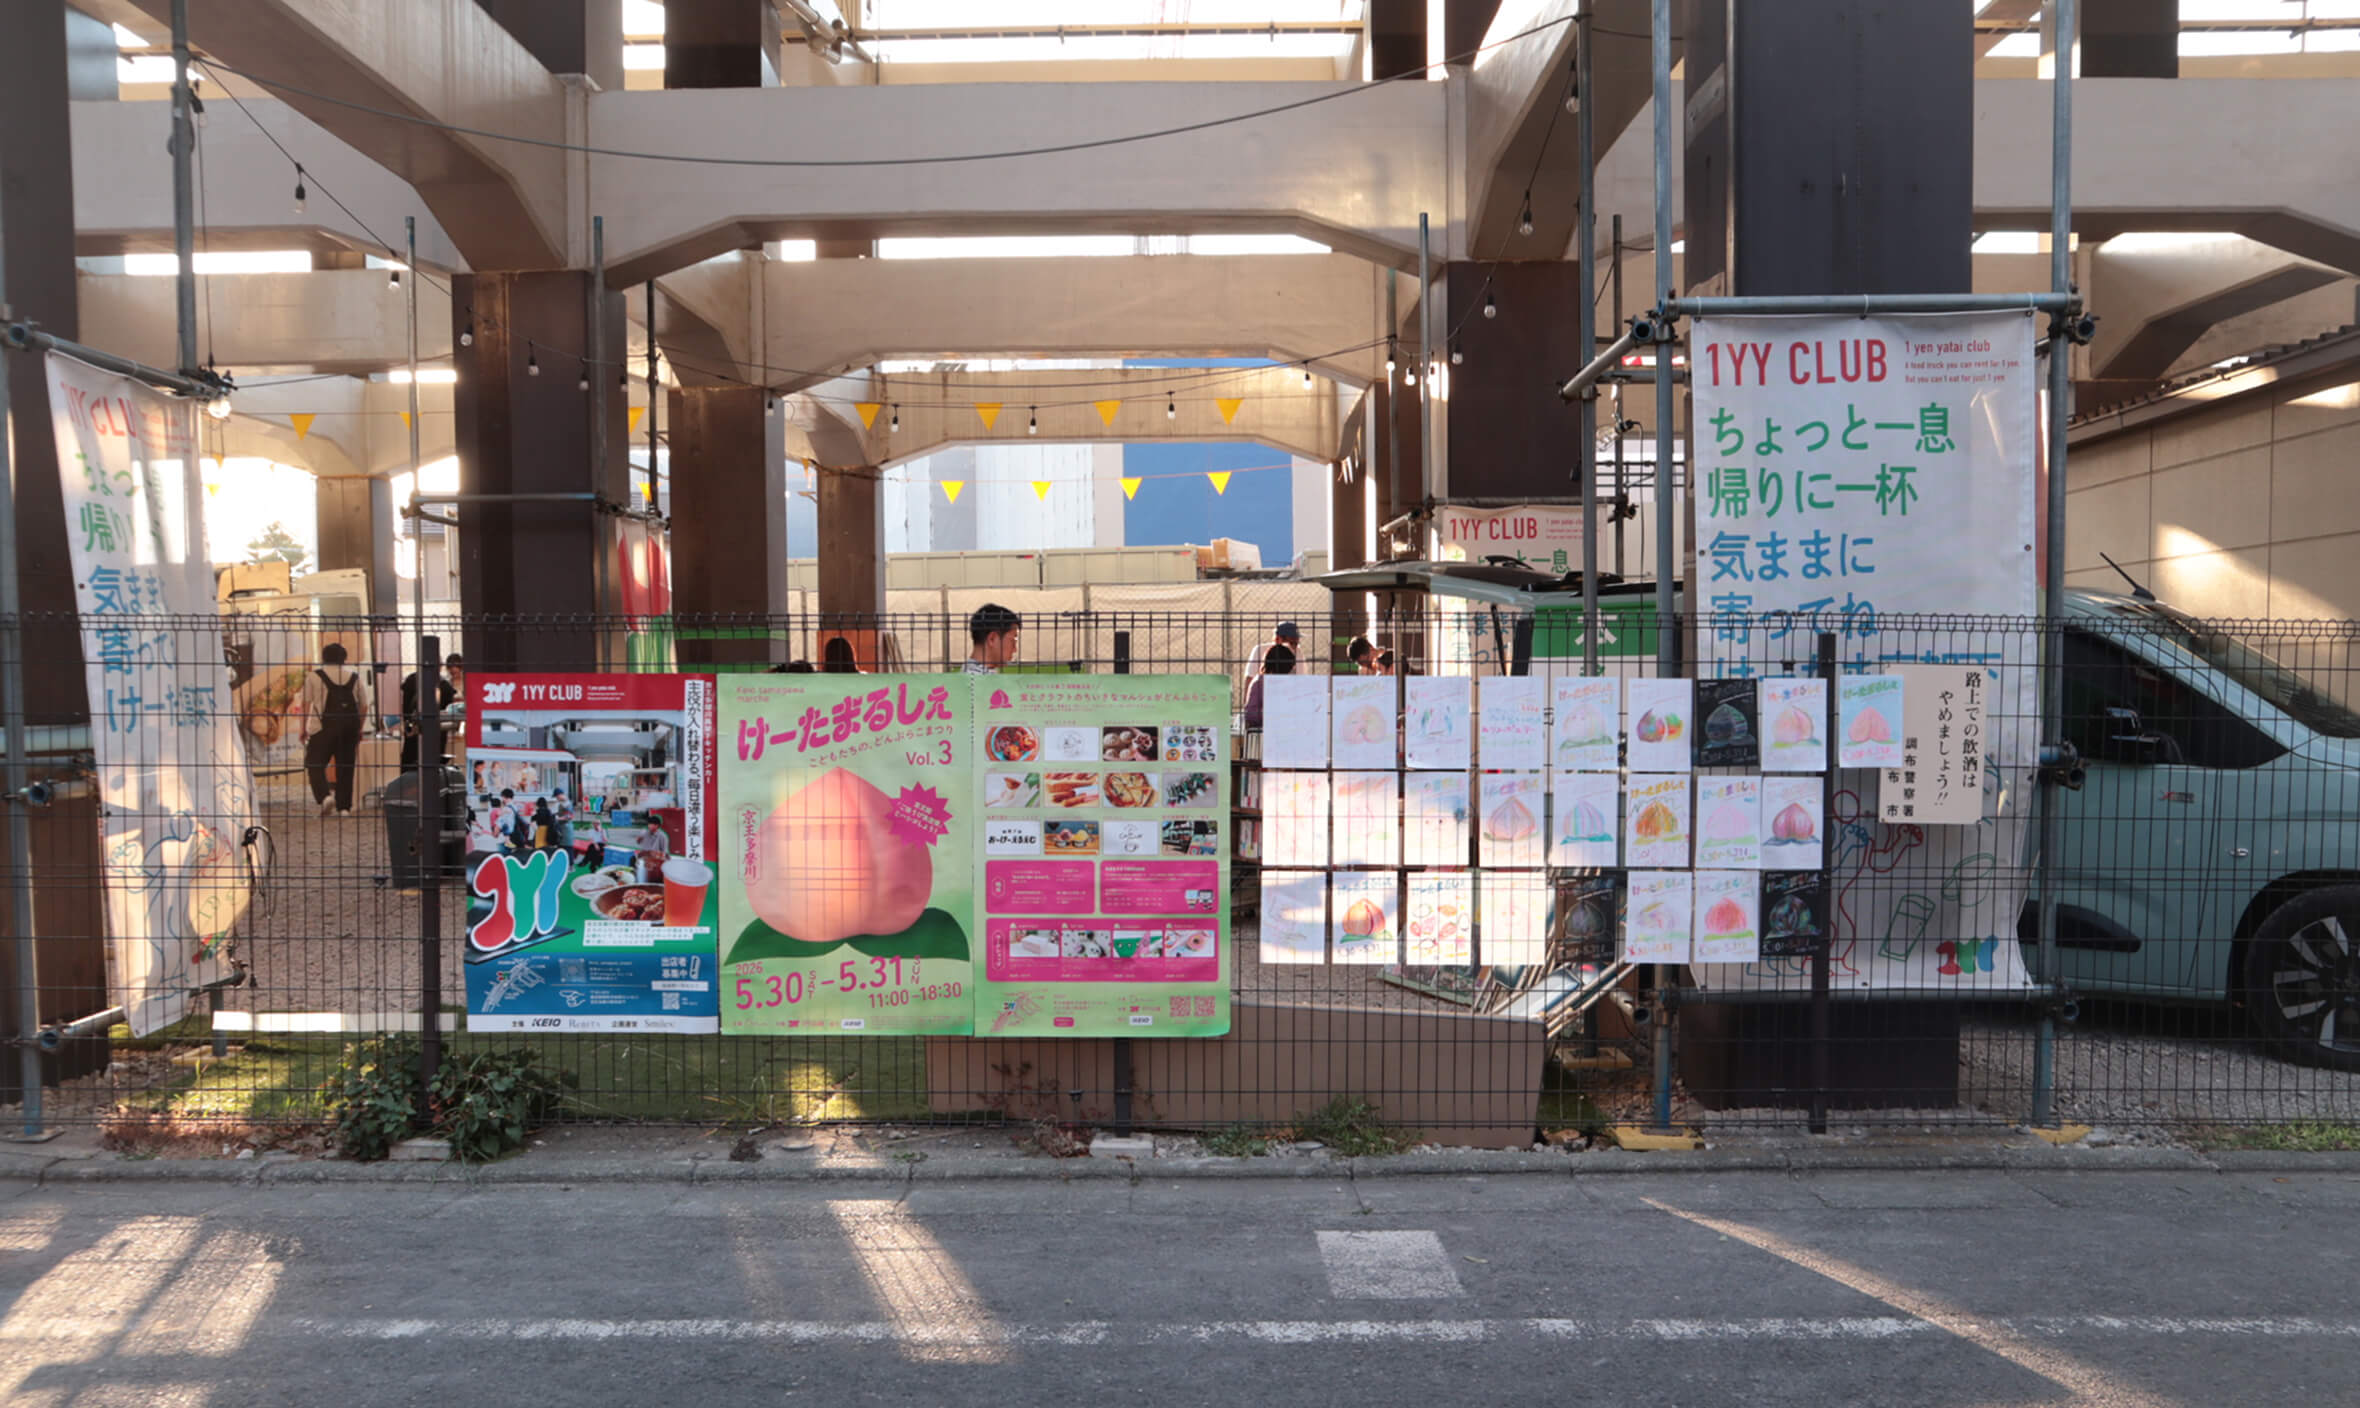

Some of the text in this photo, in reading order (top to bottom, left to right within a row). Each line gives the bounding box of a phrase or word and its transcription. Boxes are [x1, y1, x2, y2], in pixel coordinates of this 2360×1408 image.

[1706, 339, 1887, 386] 1YY CLUB
[1905, 339, 1991, 356] 1 yen yatai club
[89, 395, 137, 438] CLU
[1708, 402, 1955, 456] ちょっと一息
[1708, 463, 1918, 519] 帰りに一杯
[1450, 518, 1482, 541] 1YY
[1489, 517, 1538, 541] CLUB
[1708, 529, 1876, 582] 気ままに
[1710, 591, 1879, 644] 寄ってね
[522, 684, 546, 700] 1YY
[549, 684, 583, 701] CLUB
[1962, 671, 1982, 788] 路上での飲酒は
[906, 739, 953, 767] Vol. 3
[1887, 771, 1900, 817] 布市
[1903, 737, 1918, 817] 調布警察署
[735, 961, 763, 977] 2026
[735, 971, 803, 1010] 5.30
[807, 970, 817, 1000] SAT
[839, 955, 902, 992] 5.31
[910, 955, 921, 985] SUN
[531, 1018, 561, 1027] KEIO
